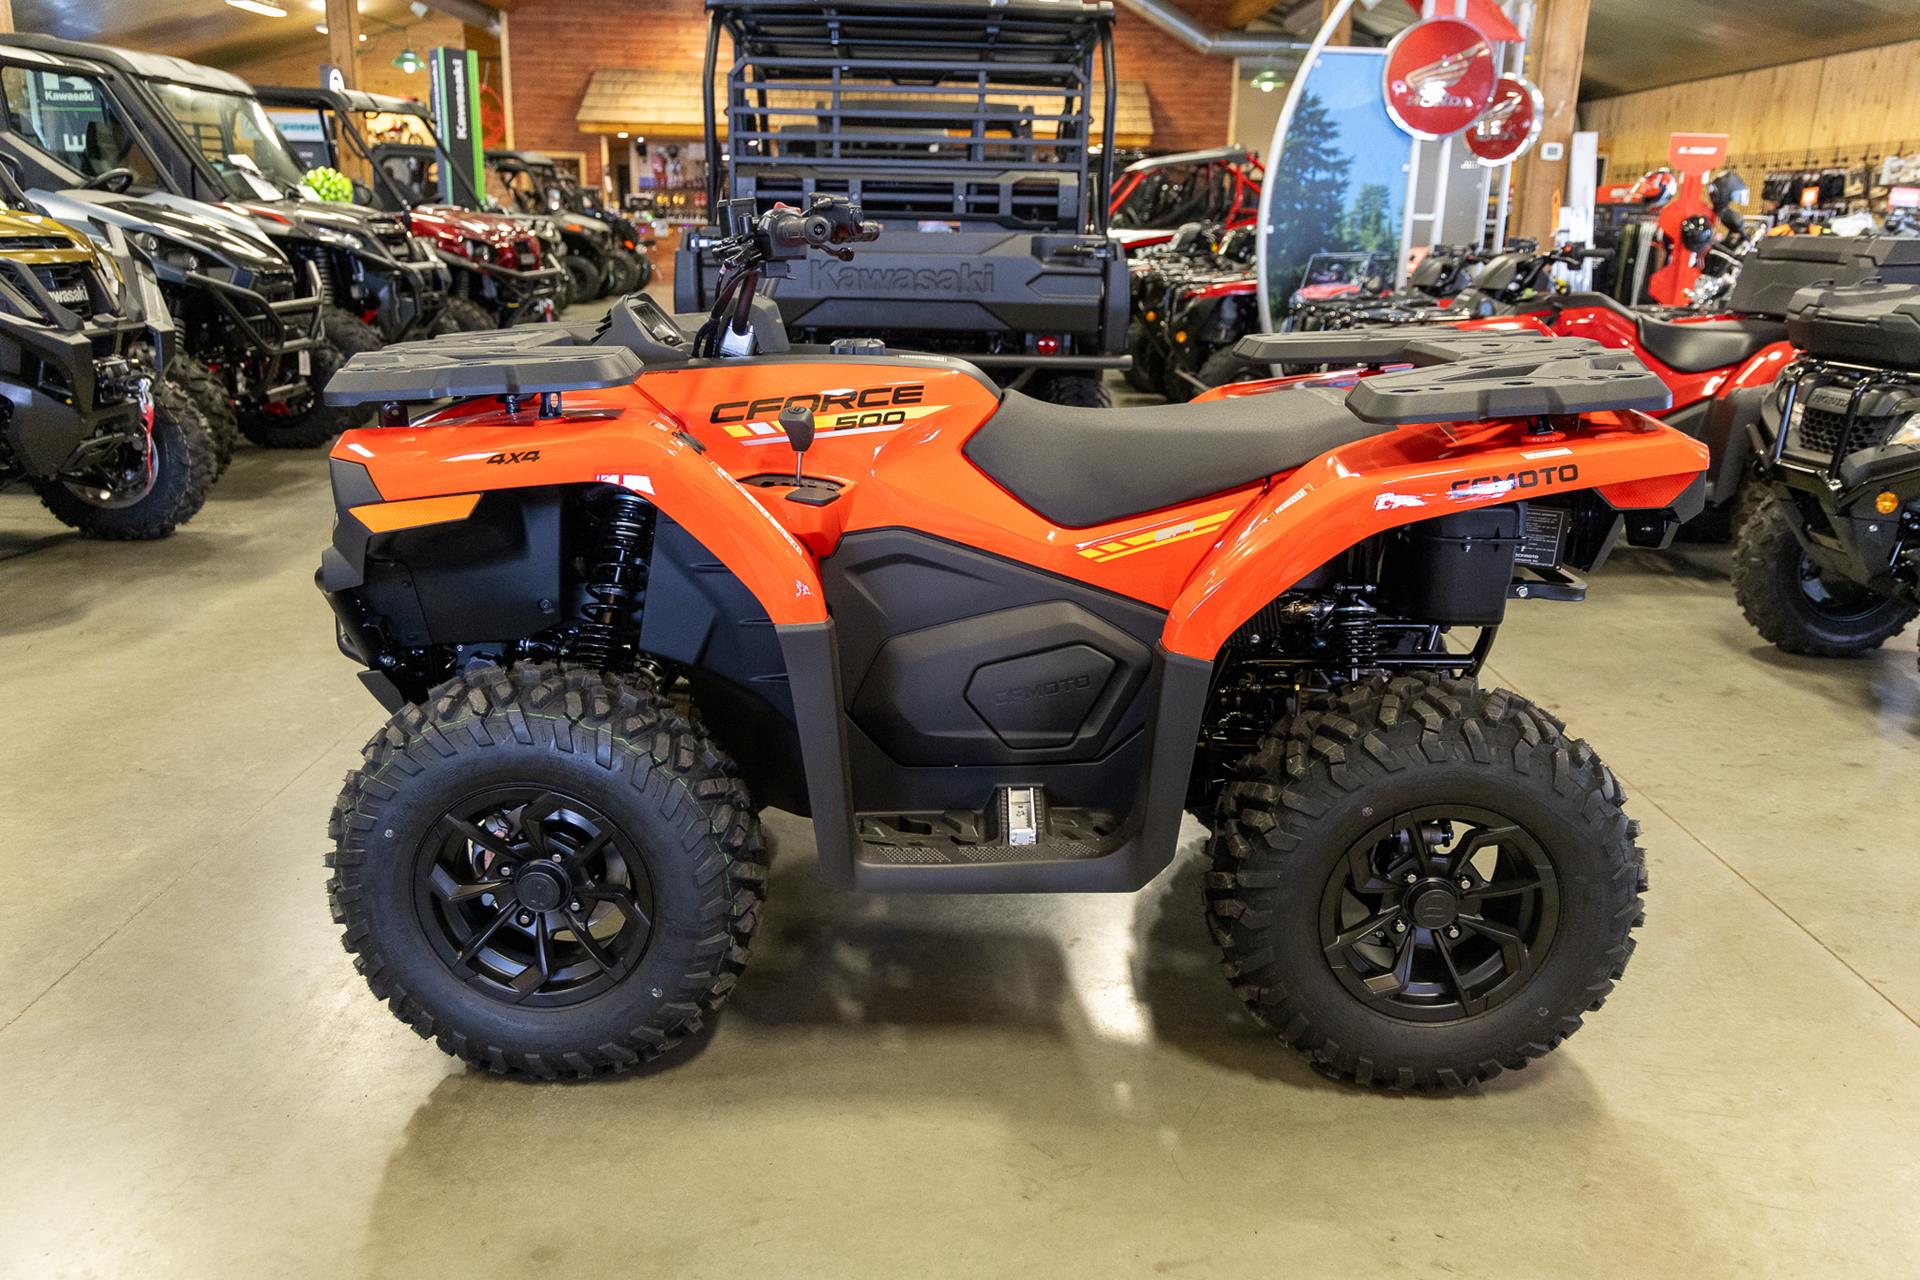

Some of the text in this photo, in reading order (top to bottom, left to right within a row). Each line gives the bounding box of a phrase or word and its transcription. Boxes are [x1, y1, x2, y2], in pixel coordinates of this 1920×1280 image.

[44, 90, 95, 102] Kawasaki
[452, 58, 468, 140] Kawasaki
[810, 258, 995, 293] Kawasaki
[709, 384, 926, 425] CFORCE
[834, 409, 907, 432] 500
